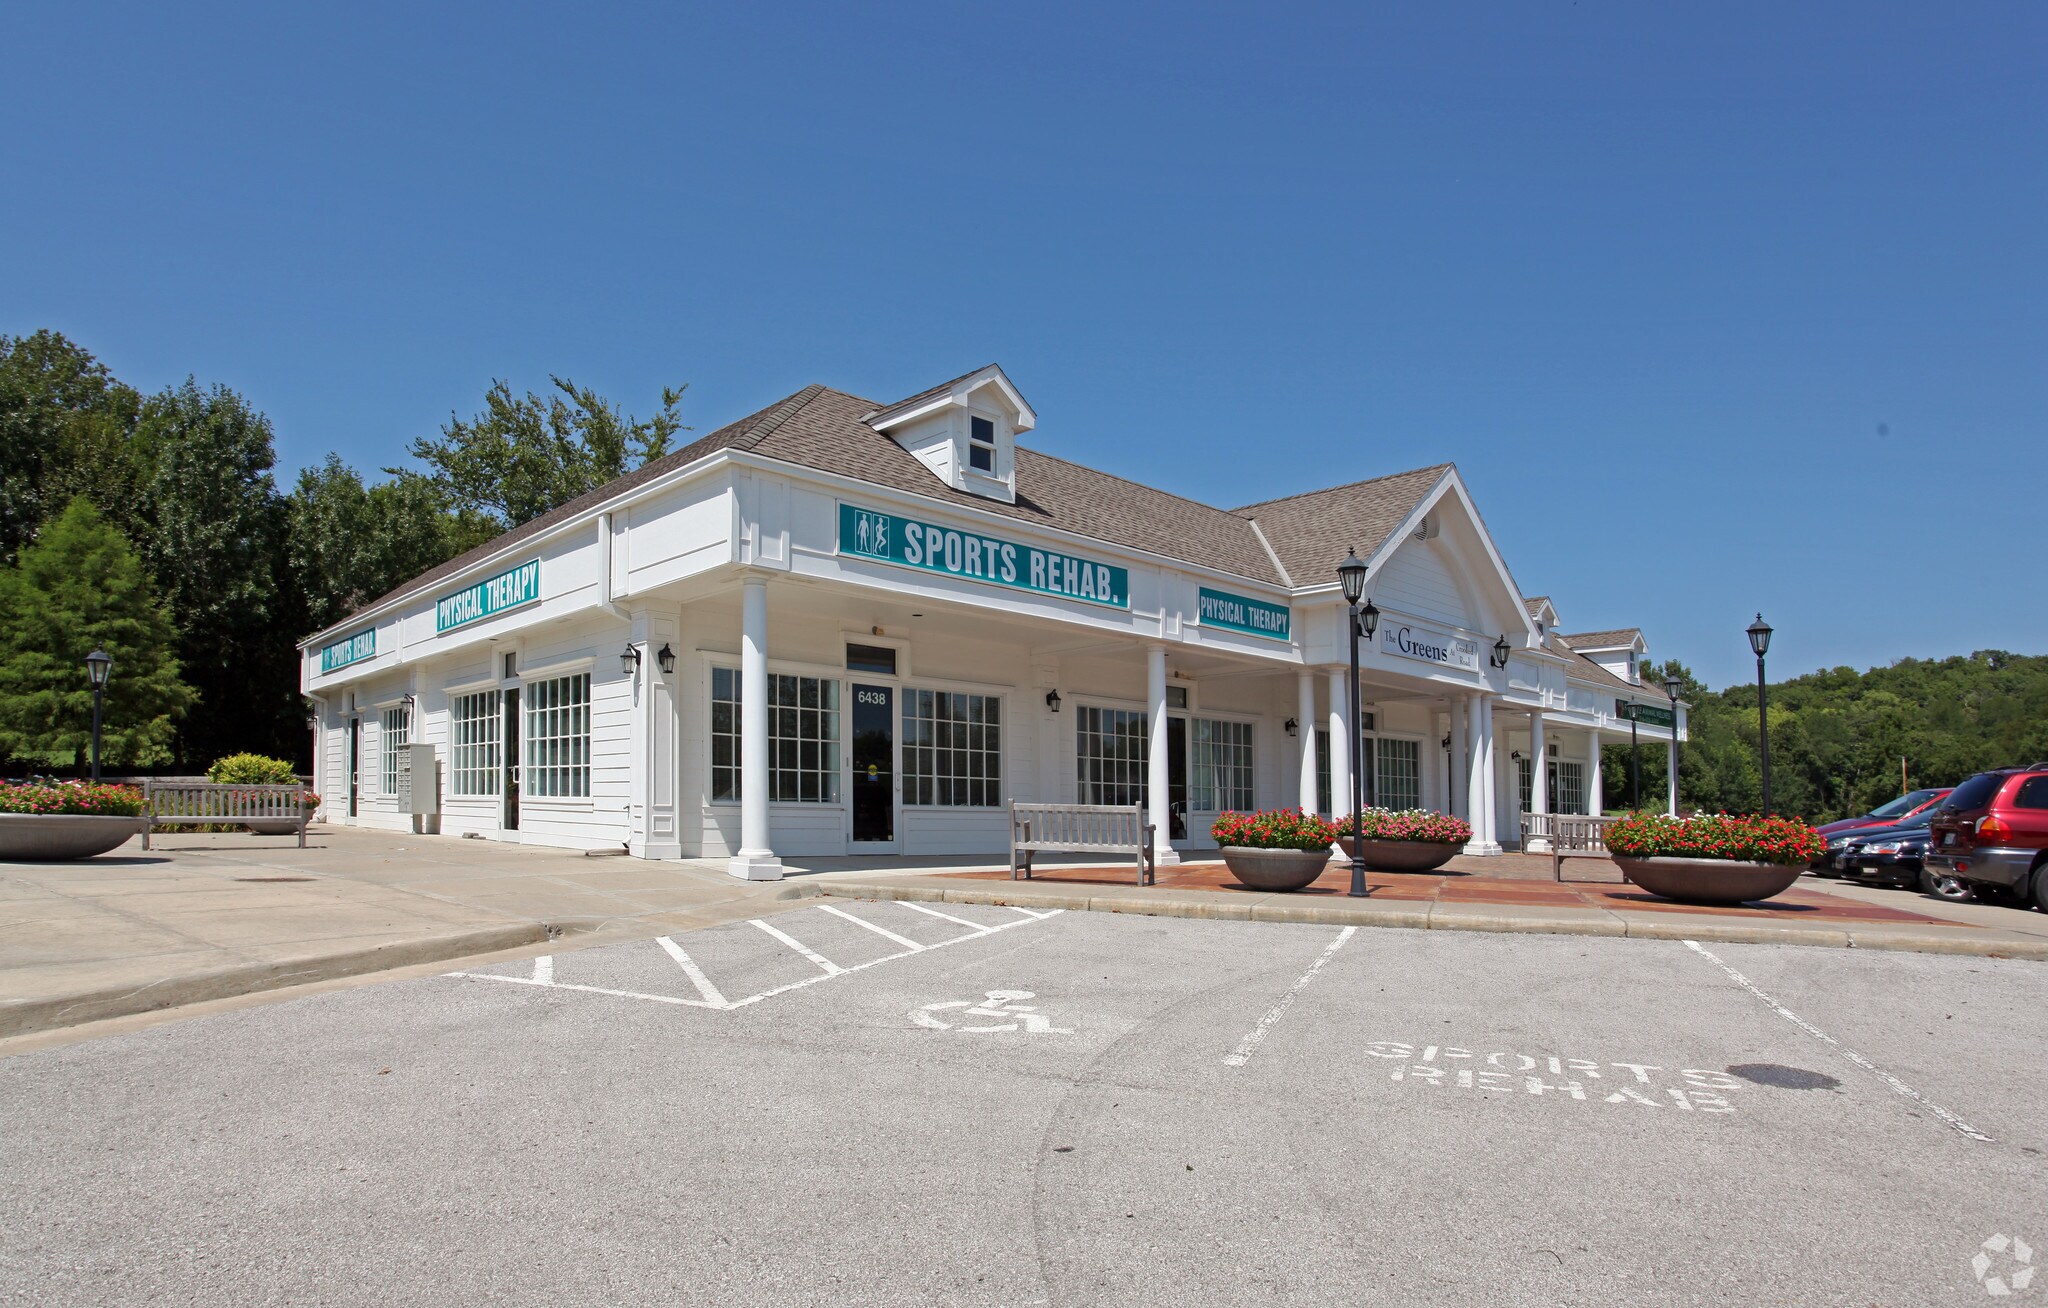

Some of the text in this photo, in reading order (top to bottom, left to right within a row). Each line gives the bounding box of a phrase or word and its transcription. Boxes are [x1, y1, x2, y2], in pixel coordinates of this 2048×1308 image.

[904, 522, 1119, 604] SPORTS REHAB.
[440, 562, 537, 629] PHYSICAL THERAPY
[1200, 595, 1287, 633] PHYSICAL THERAPY
[331, 640, 352, 667] SPORTS
[1384, 629, 1396, 643] The
[1398, 627, 1448, 662] Greens
[858, 691, 886, 705] 6438
[1364, 1041, 1741, 1090] SPORTS
[1391, 1064, 1737, 1114] REHAB
